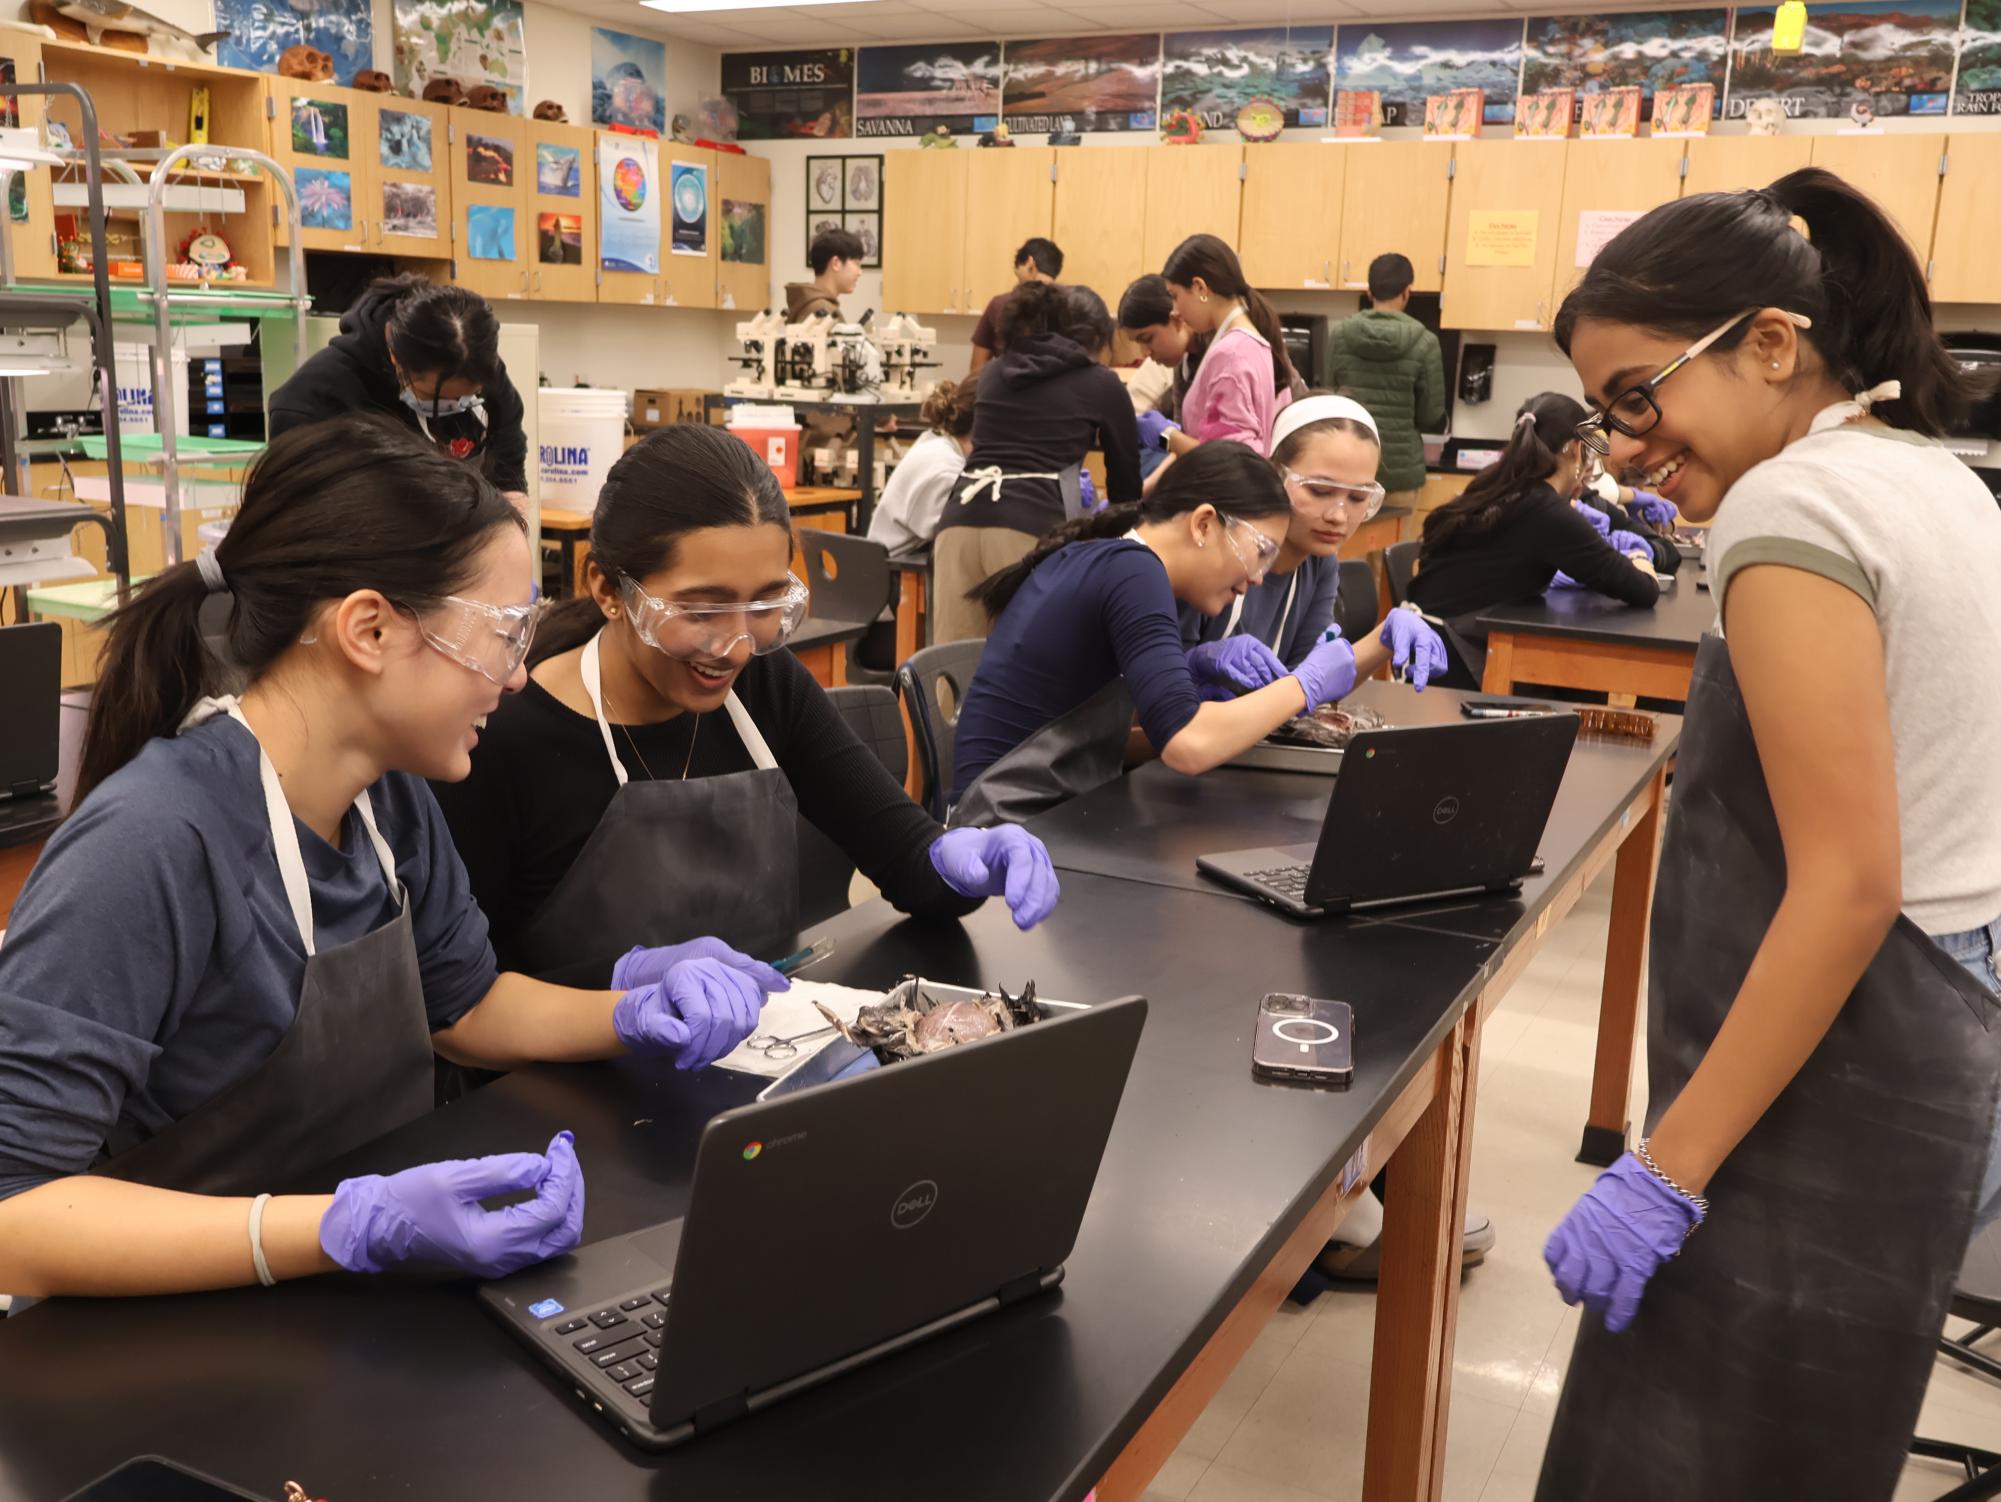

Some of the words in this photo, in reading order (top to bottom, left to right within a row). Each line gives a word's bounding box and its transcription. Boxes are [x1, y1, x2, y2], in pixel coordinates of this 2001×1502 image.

[1957, 103, 1988, 112] RAIN
[857, 119, 913, 136] SAVANNA
[1436, 805, 1456, 816] DELL
[766, 1130, 808, 1150] chrome
[896, 1195, 932, 1217] DELL
